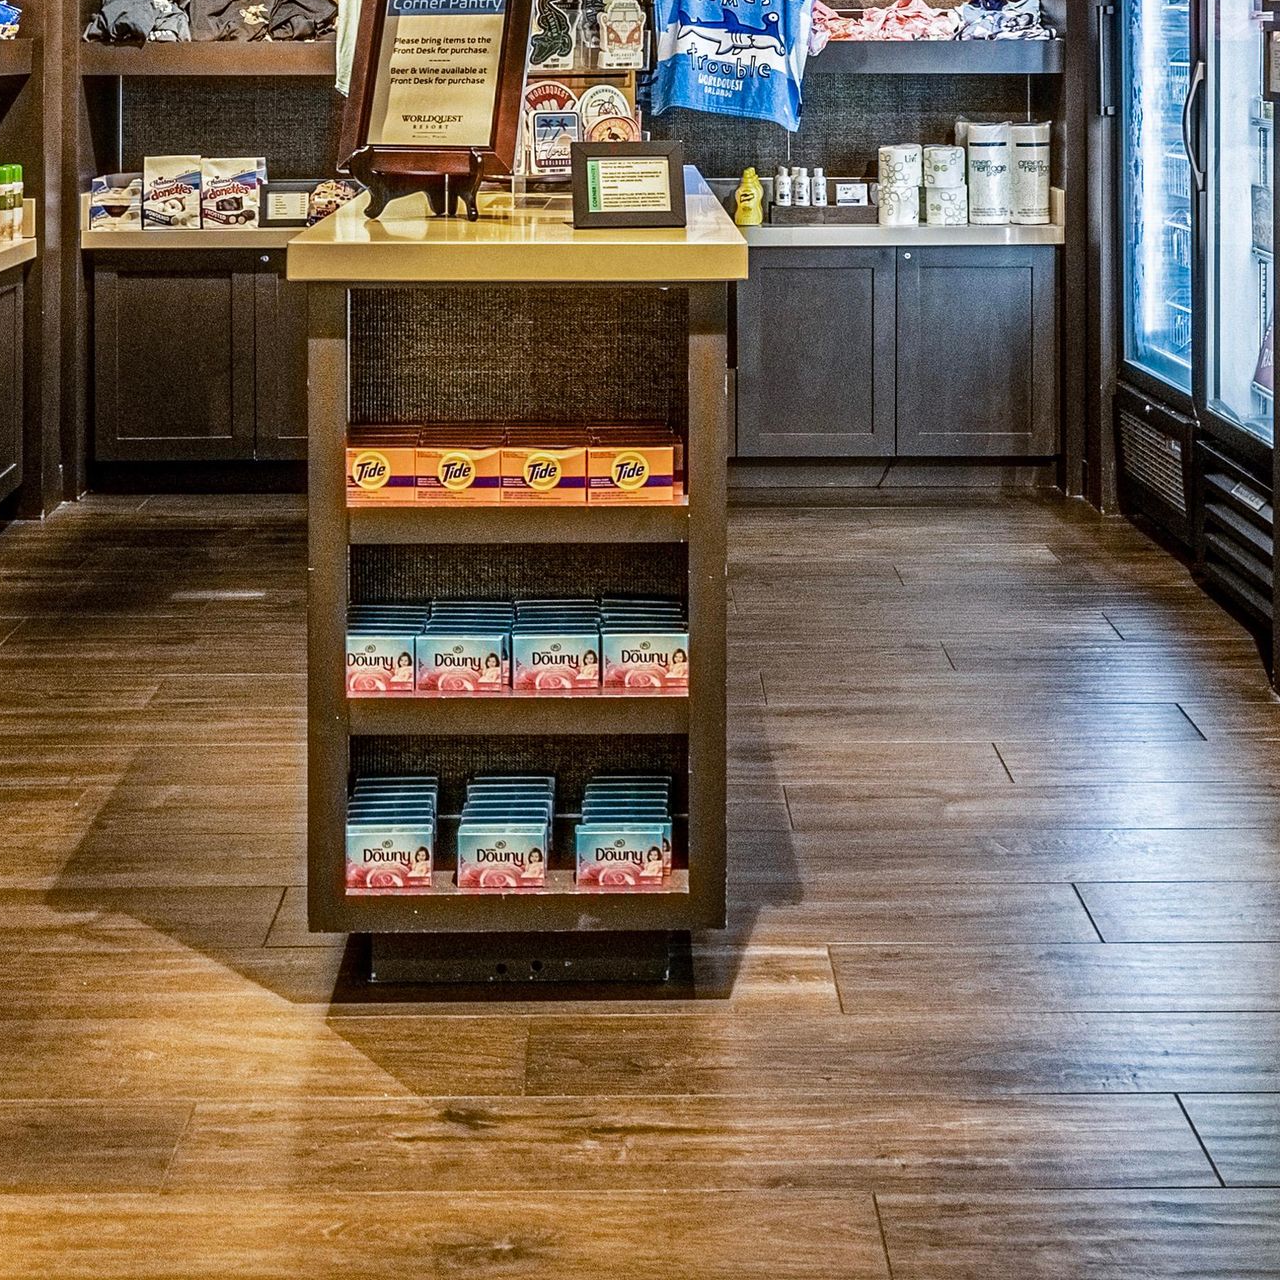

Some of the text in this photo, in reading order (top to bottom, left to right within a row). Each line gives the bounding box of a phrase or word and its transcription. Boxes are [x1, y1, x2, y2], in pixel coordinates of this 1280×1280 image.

[393, 46, 490, 56] Front Desk for purchase.
[394, 36, 492, 47] Please bring items to the
[390, 67, 409, 75] Beer
[410, 67, 417, 75] &
[419, 66, 440, 75] Wine
[440, 66, 477, 75] available
[390, 77, 485, 87] Front Desk for purchase
[698, 73, 744, 91] WORLDQUEST
[527, 84, 569, 101] WORLDQUEST
[401, 114, 463, 125] WORLDQUEST
[151, 183, 193, 200] donettes
[208, 183, 249, 200] donettes
[204, 209, 227, 220] FROSTED
[356, 462, 386, 483] Tide
[442, 462, 472, 483] Tide
[527, 462, 558, 483] Tide
[614, 461, 645, 482] Tide
[347, 652, 393, 671] Downy
[434, 652, 482, 671] Downy
[532, 651, 579, 670] Downy
[621, 649, 669, 668] Downy
[363, 848, 411, 867] Downy
[476, 848, 524, 867] Downy
[595, 847, 643, 866] Downy
